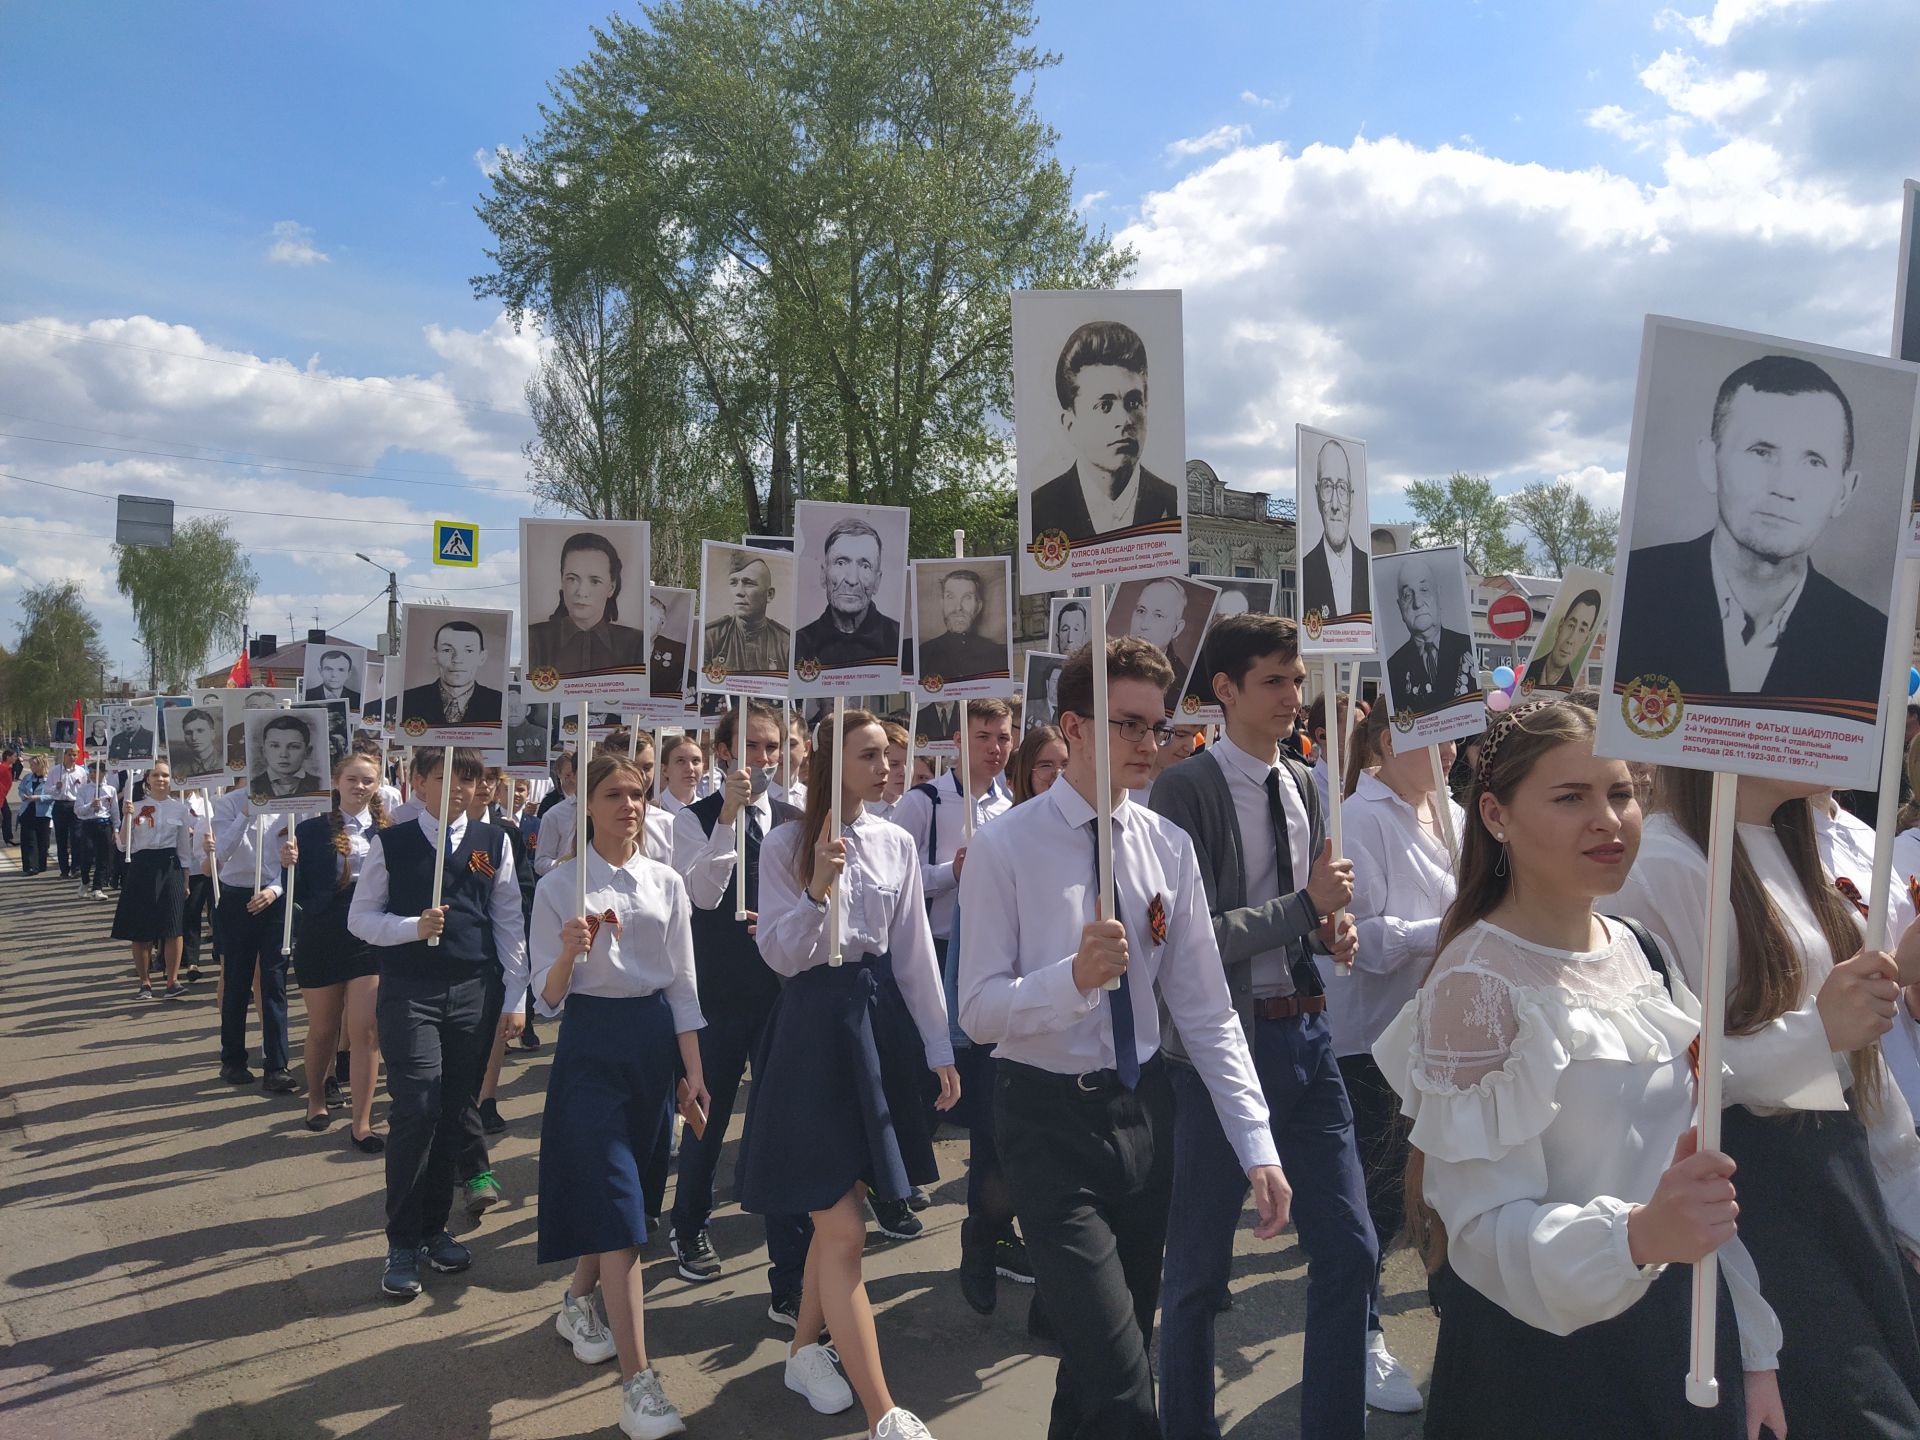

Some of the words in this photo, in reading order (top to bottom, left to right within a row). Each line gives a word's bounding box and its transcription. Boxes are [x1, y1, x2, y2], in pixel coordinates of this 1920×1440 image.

[1071, 548, 1100, 558] КУЛЯСОВ
[1100, 544, 1136, 555] АЛЕКСАНДР
[1136, 540, 1167, 550] ПЕТРОВИЧ
[1093, 558, 1107, 566] Герой
[1108, 555, 1134, 564] Советского
[1118, 564, 1138, 572] Красной
[1684, 723, 1697, 732] 2-й
[1699, 726, 1746, 738] Украинский
[1747, 732, 1772, 742] фронт
[1788, 738, 1832, 749] отдельный
[1686, 712, 1751, 729] ГАРИФУЛЛИН
[1755, 721, 1790, 734] ФАТЫХ
[1792, 726, 1864, 743] ШАЙДУЛЛОВИЧ
[1682, 744, 1720, 756] разъезда
[1683, 734, 1760, 750] эксплуатационный
[1761, 745, 1782, 753] полк.
[1784, 746, 1802, 755] Пом.
[1804, 752, 1849, 761] начальника
